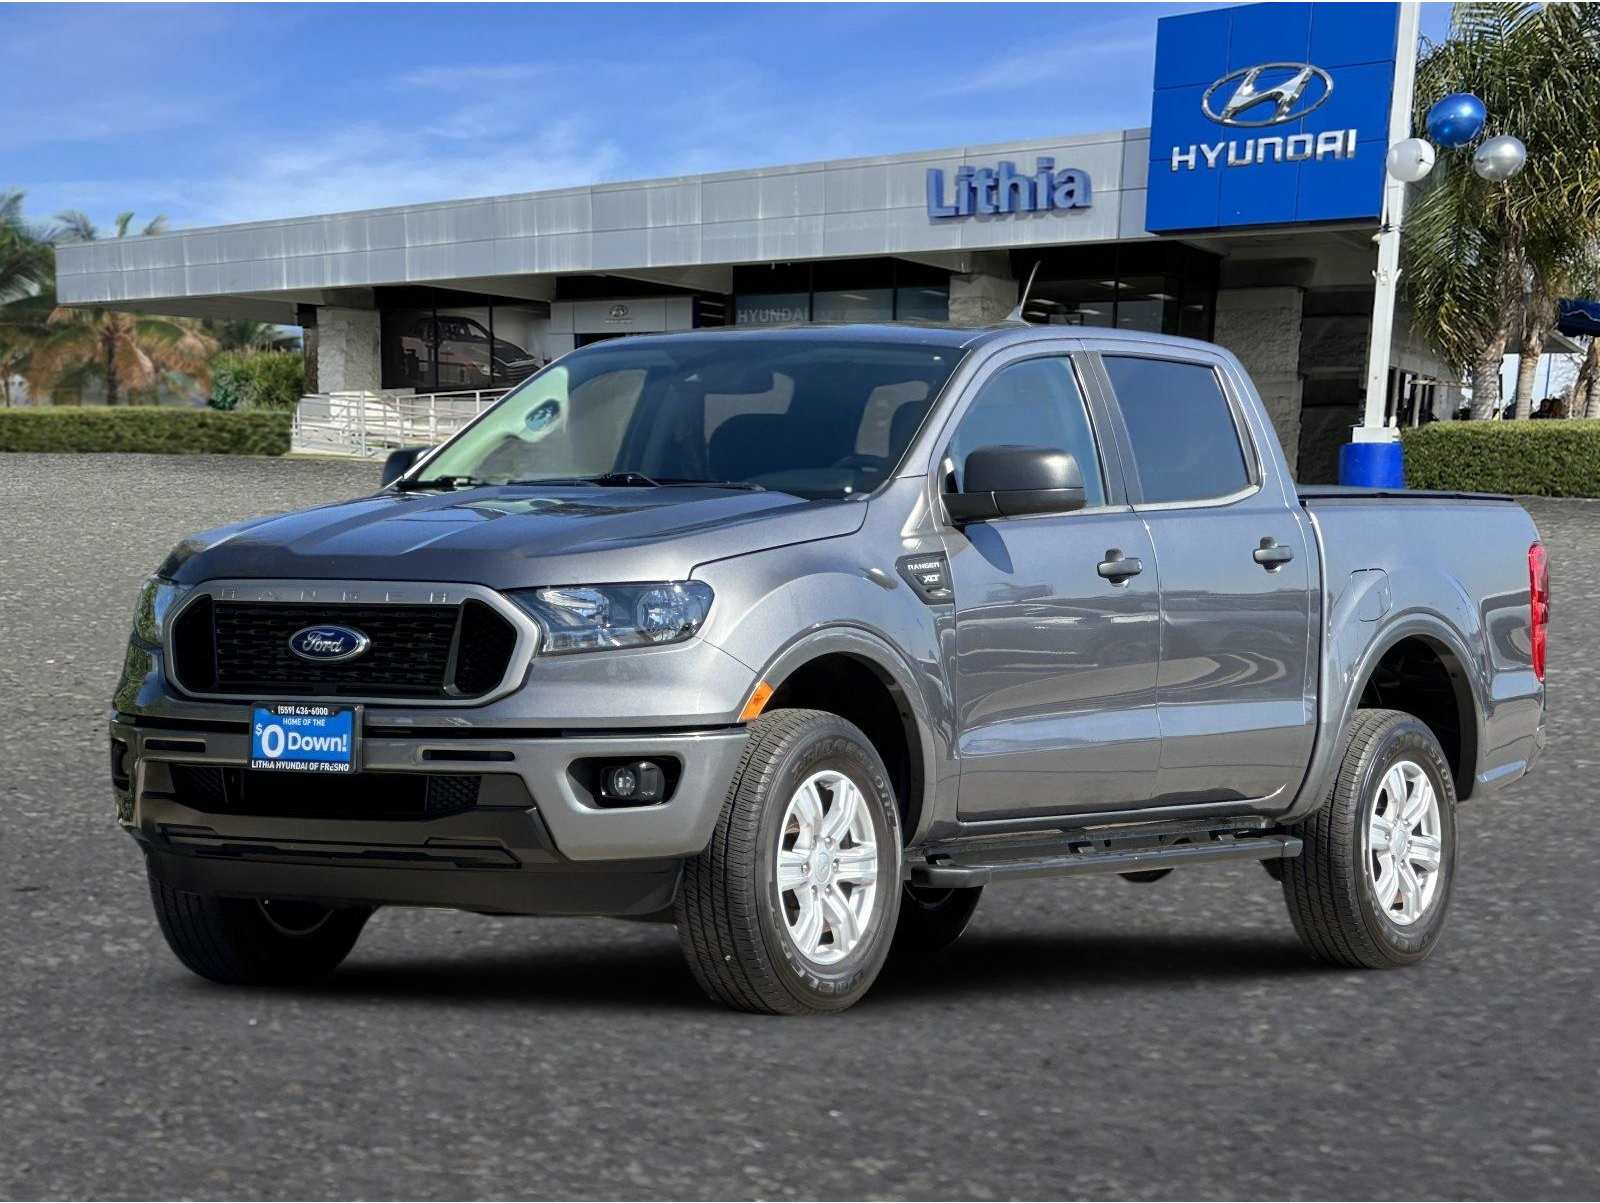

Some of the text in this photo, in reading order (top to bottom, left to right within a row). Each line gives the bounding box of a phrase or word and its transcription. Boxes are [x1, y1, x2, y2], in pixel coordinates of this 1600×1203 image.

[1171, 128, 1357, 172] HYUNDAI
[926, 156, 1092, 218] Lithia
[737, 306, 809, 323] HYUNDAI
[907, 561, 940, 571] RANGER
[922, 574, 940, 584] XLT
[302, 631, 343, 654] Ford
[277, 705, 328, 716] (559) 436-6000
[282, 717, 326, 727] HOME OF THE
[287, 731, 348, 752] Down!
[251, 760, 350, 772] LITHIA HYUNDAI OF FRESNO
